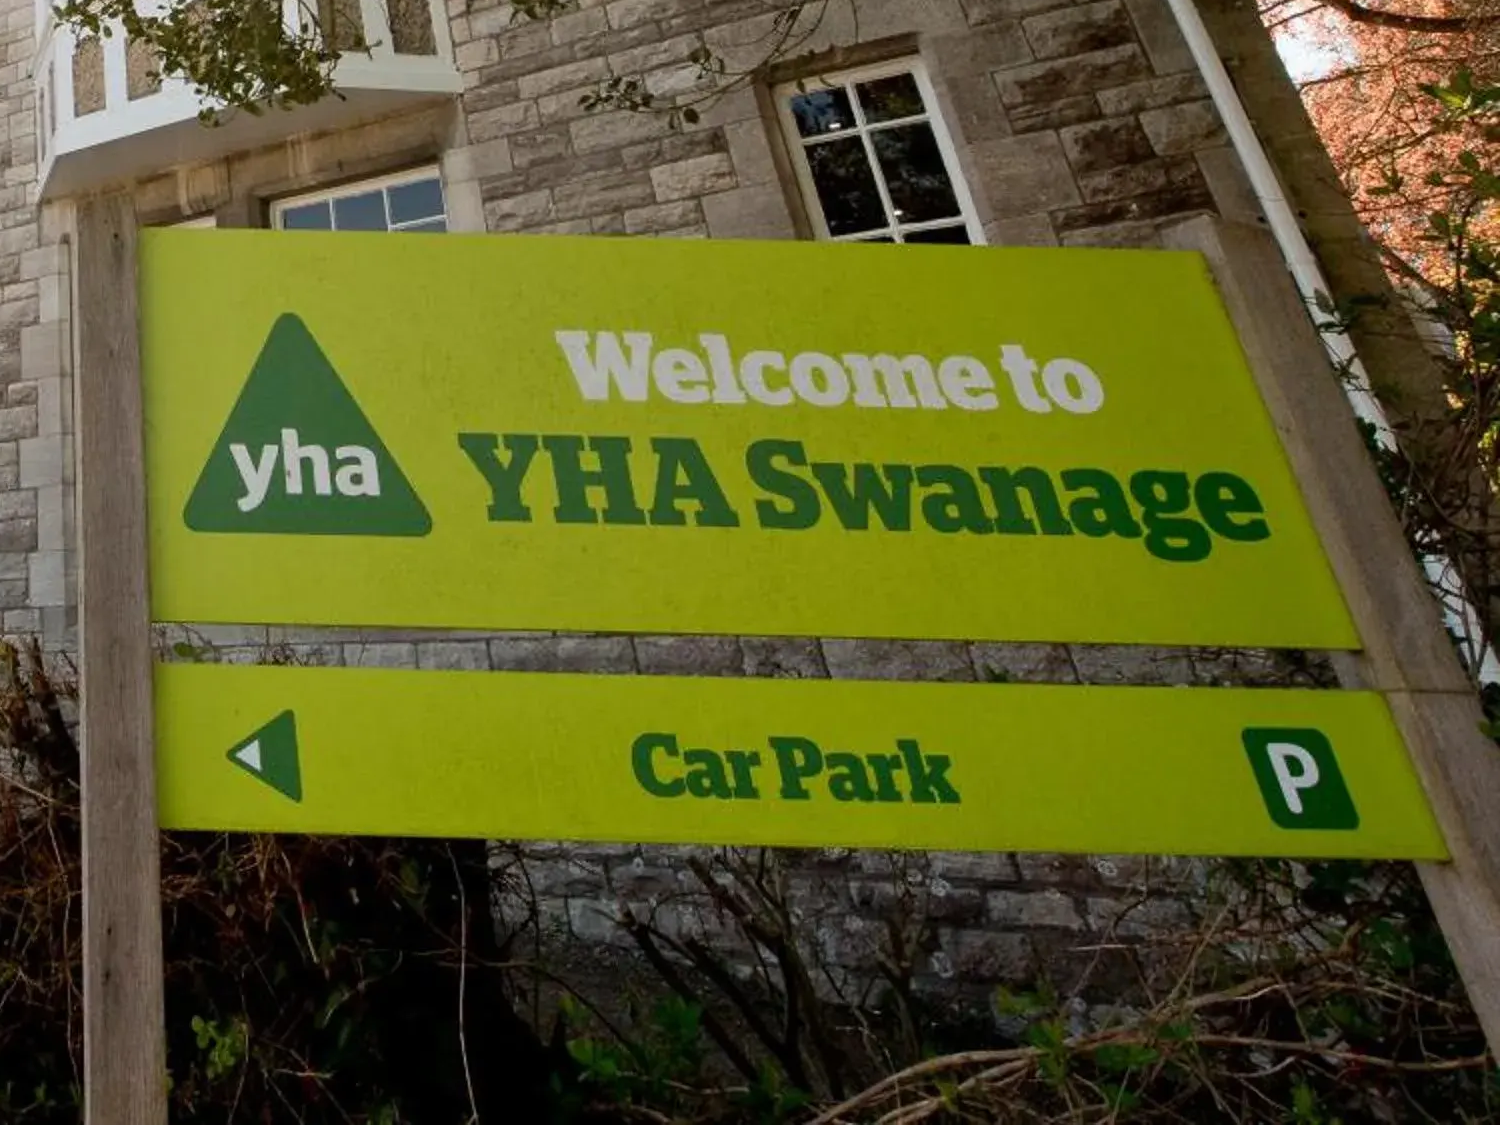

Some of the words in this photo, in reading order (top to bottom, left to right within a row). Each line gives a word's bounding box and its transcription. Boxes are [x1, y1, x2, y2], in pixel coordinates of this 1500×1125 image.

[555, 330, 998, 410] Welcome
[999, 344, 1104, 413] to
[229, 428, 381, 512] yha
[457, 432, 740, 528] YHA
[745, 439, 1271, 562] Swanage
[631, 732, 761, 801] Car
[768, 736, 960, 804] Park
[1267, 741, 1320, 815] P
